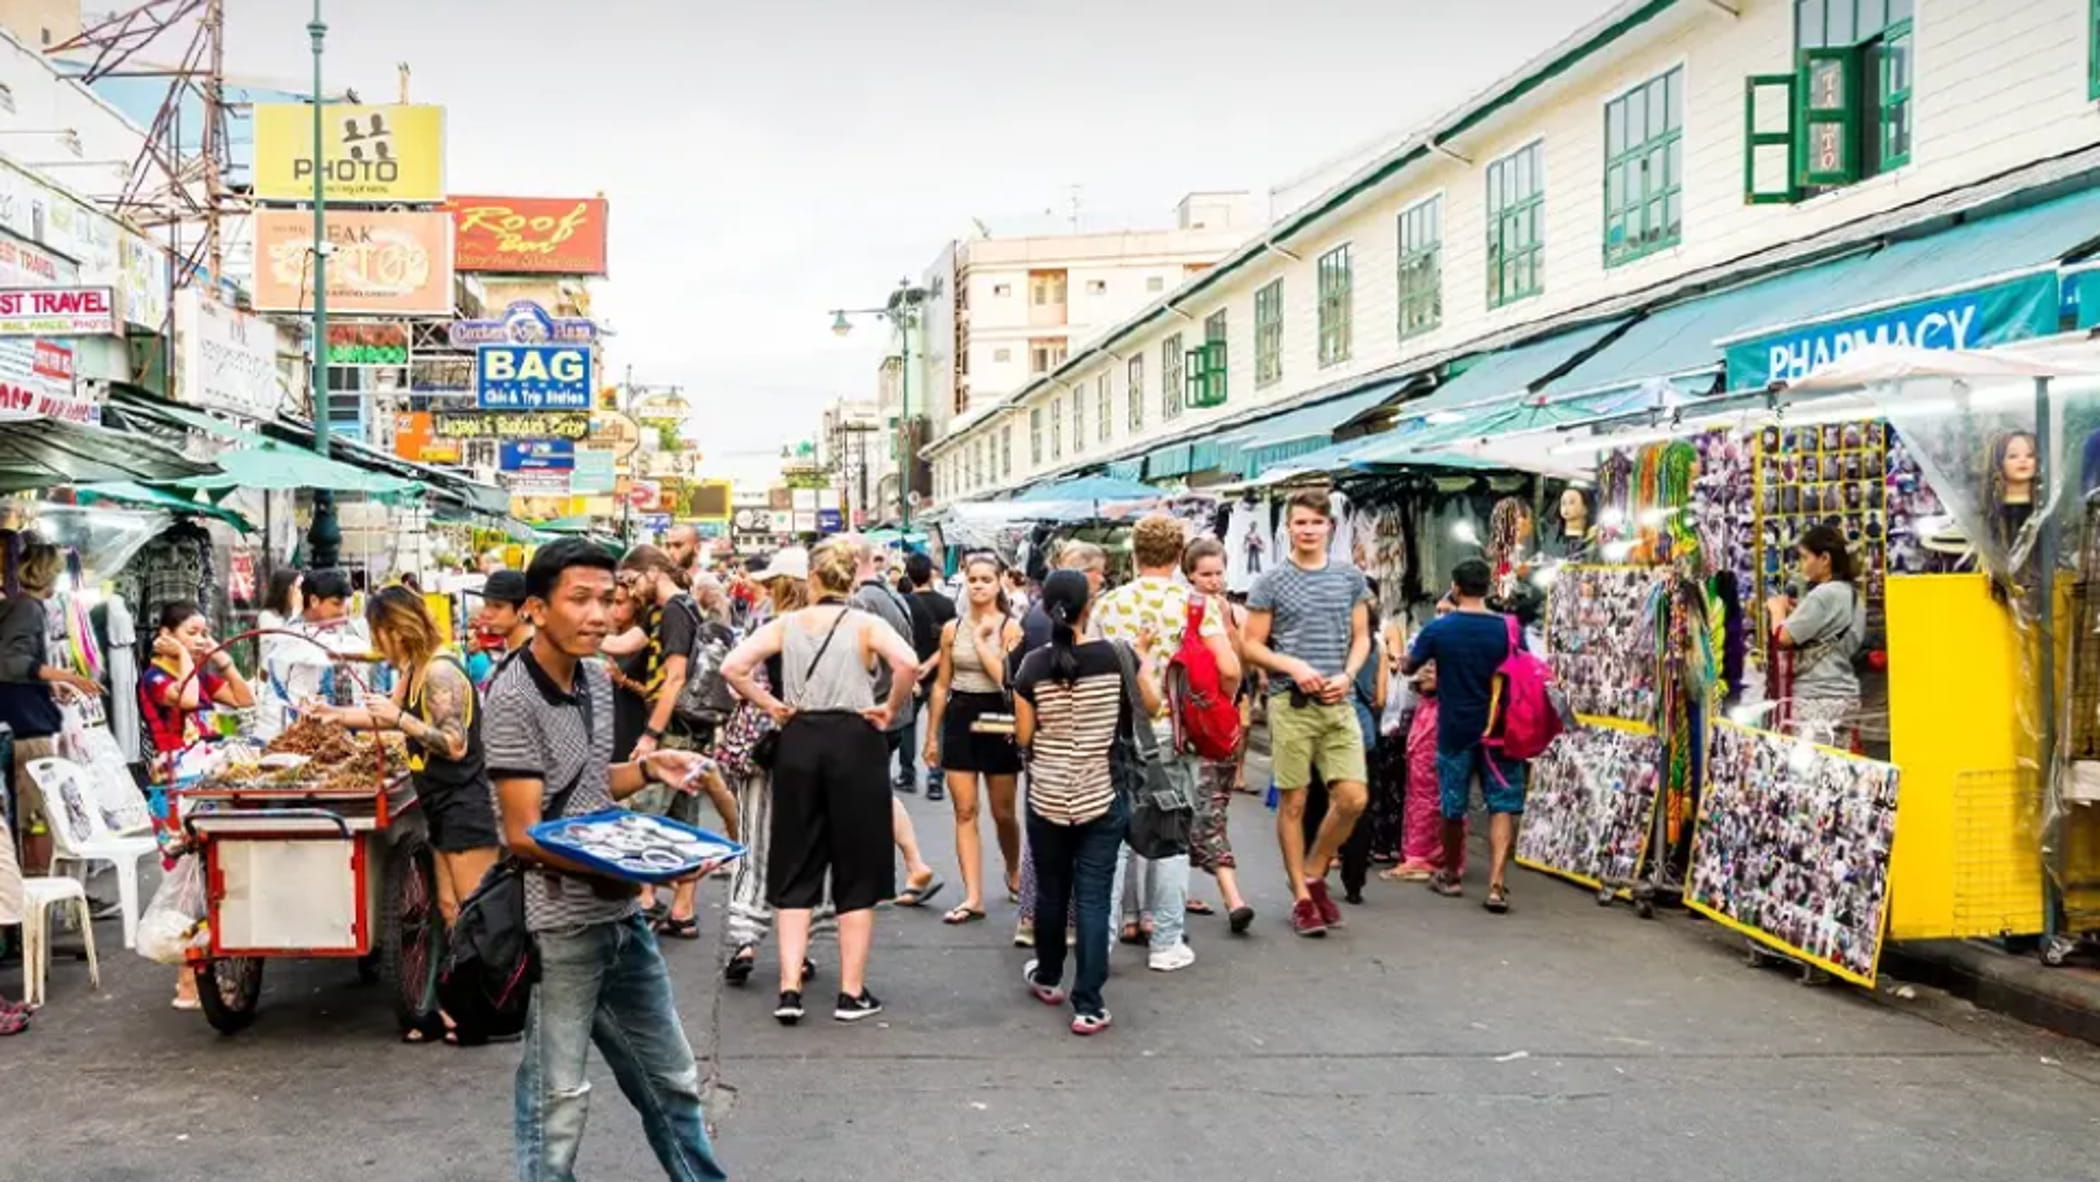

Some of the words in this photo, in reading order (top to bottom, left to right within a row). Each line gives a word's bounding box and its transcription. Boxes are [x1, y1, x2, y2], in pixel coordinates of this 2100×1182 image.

[294, 159, 398, 182] PHOTO
[460, 202, 587, 243] Roof
[30, 291, 109, 315] TRAVEL
[1769, 305, 1976, 381] PHARMACY
[484, 350, 585, 382] BAG
[522, 388, 542, 406] Trip
[546, 388, 585, 404] Station
